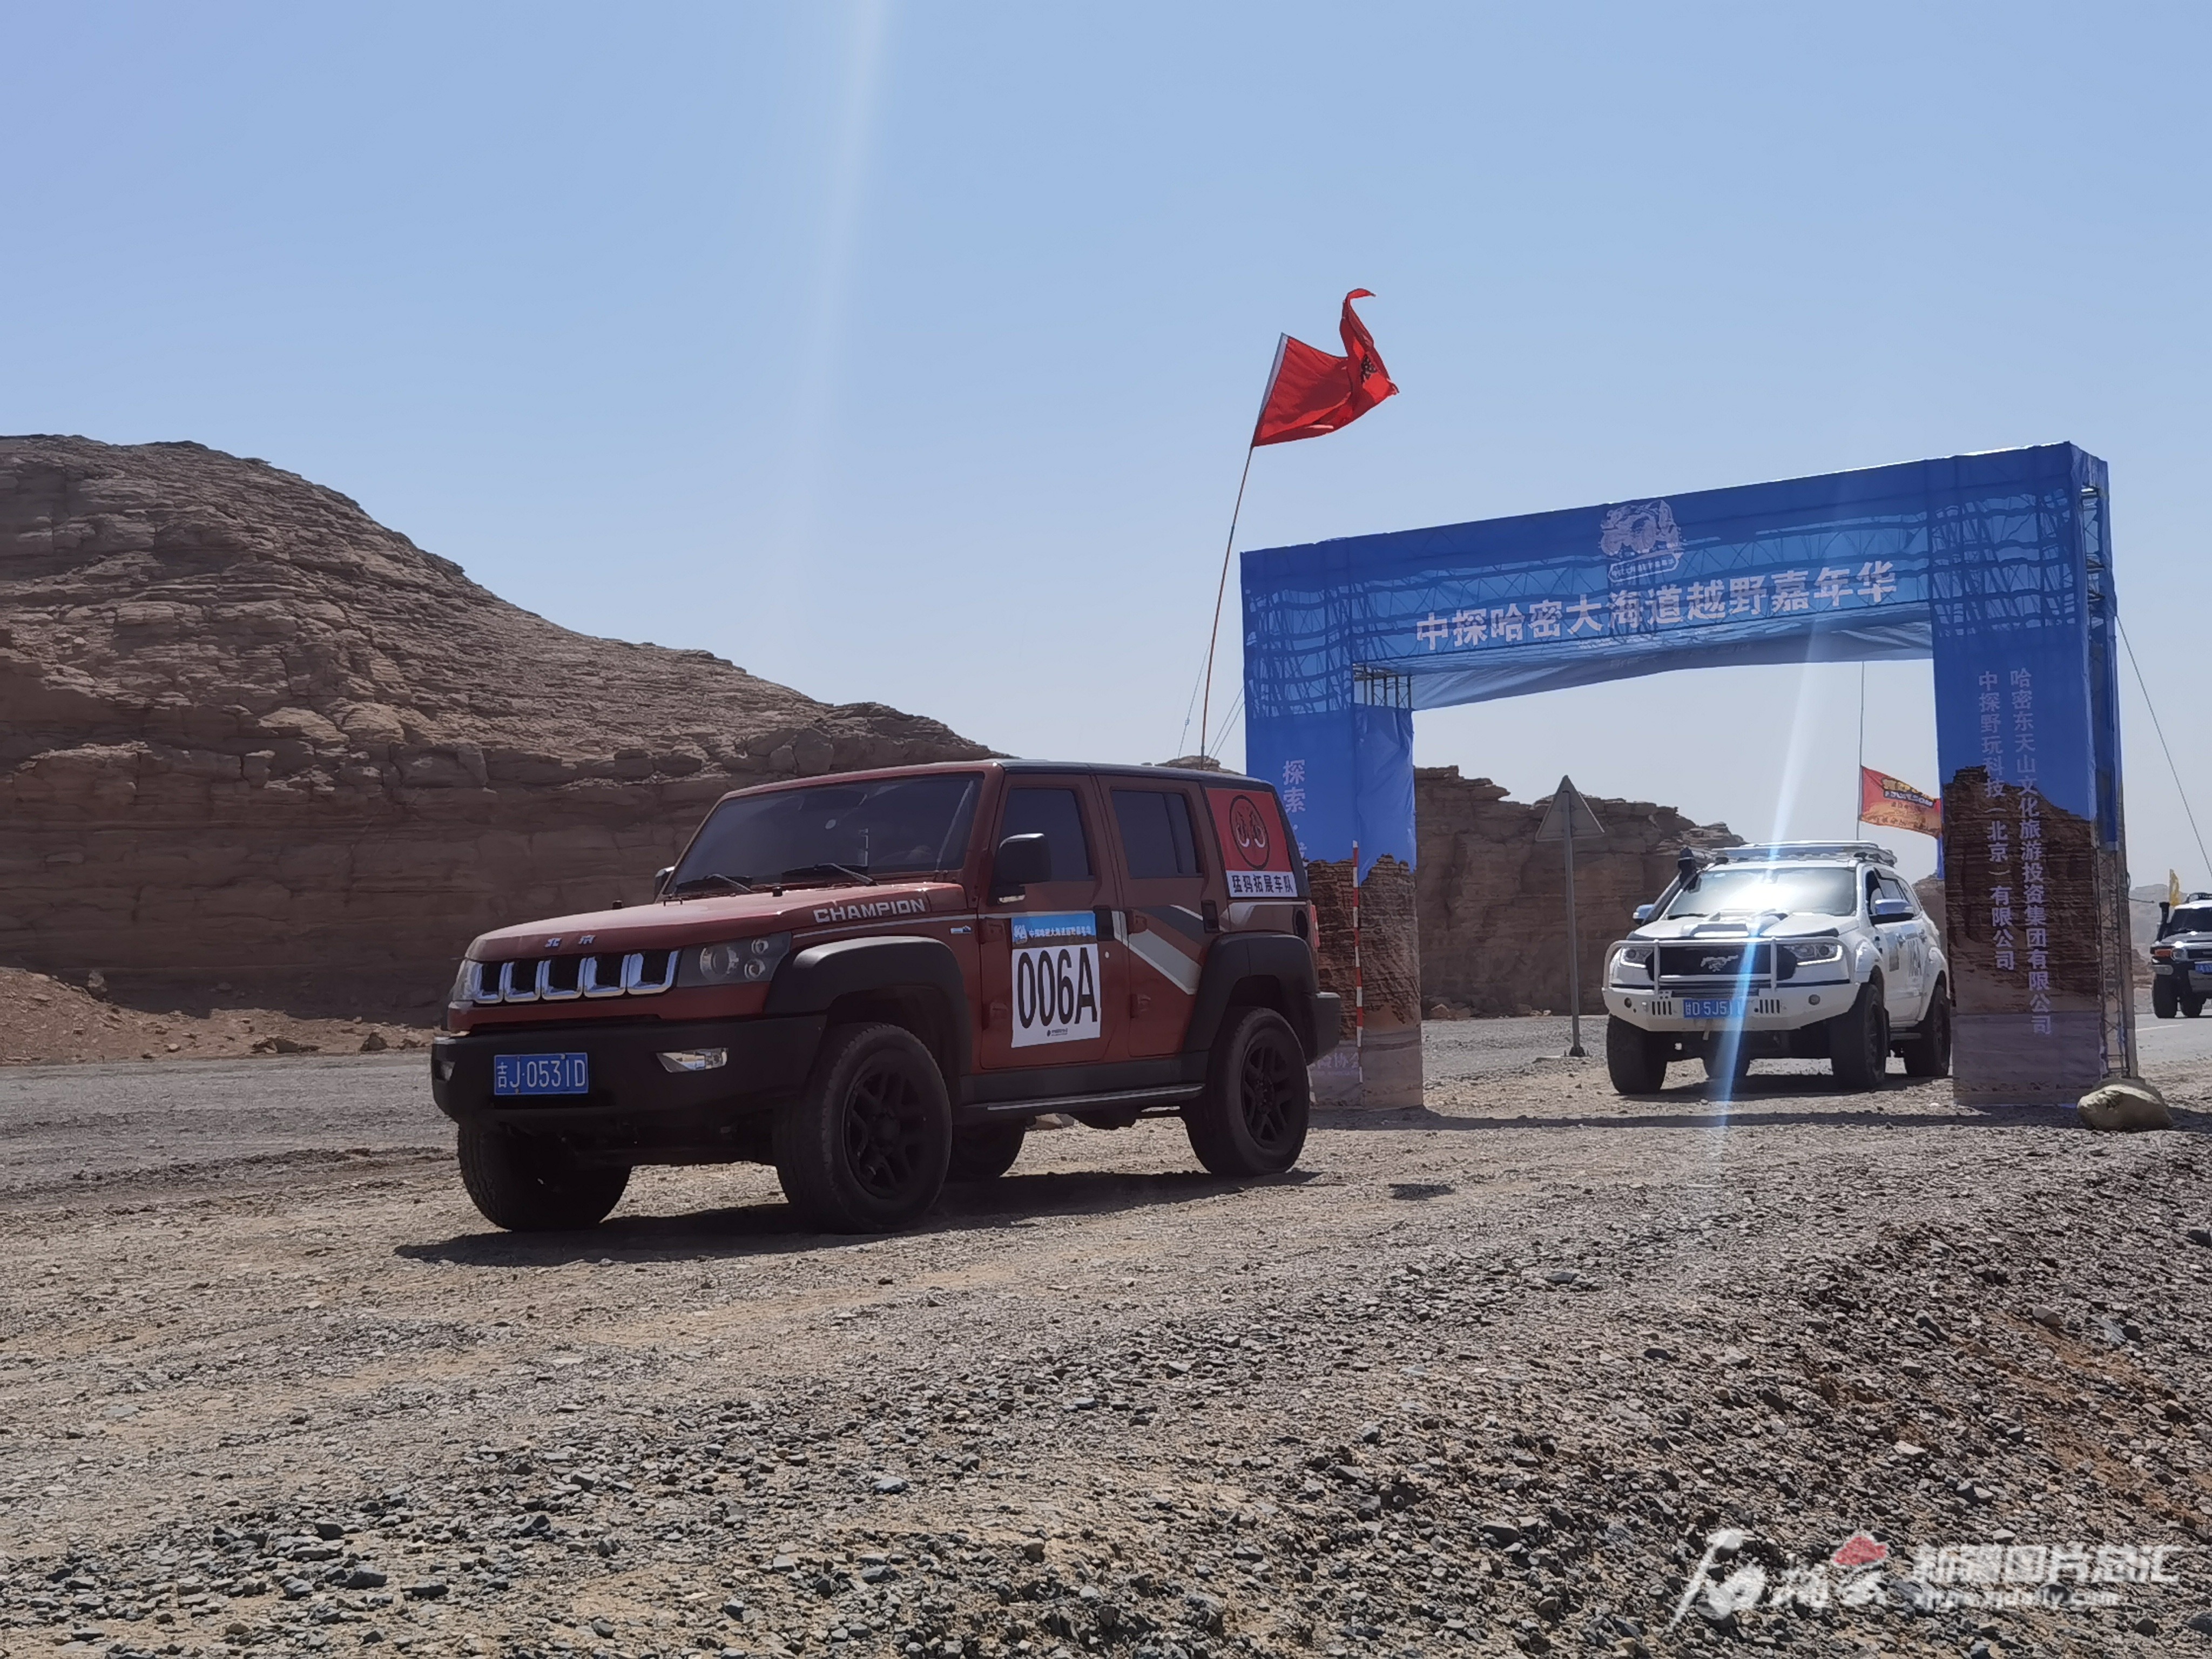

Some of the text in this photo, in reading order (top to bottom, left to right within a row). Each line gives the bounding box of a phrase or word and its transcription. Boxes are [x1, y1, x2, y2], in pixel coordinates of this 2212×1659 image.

[1415, 559, 1897, 651] 中探哈密大海道越野嘉年华
[2009, 667, 2051, 1035] 哈密东天山文化旅游投资集团有限公司
[813, 898, 926, 923] CHAMPION
[1017, 947, 1098, 1029] 006A
